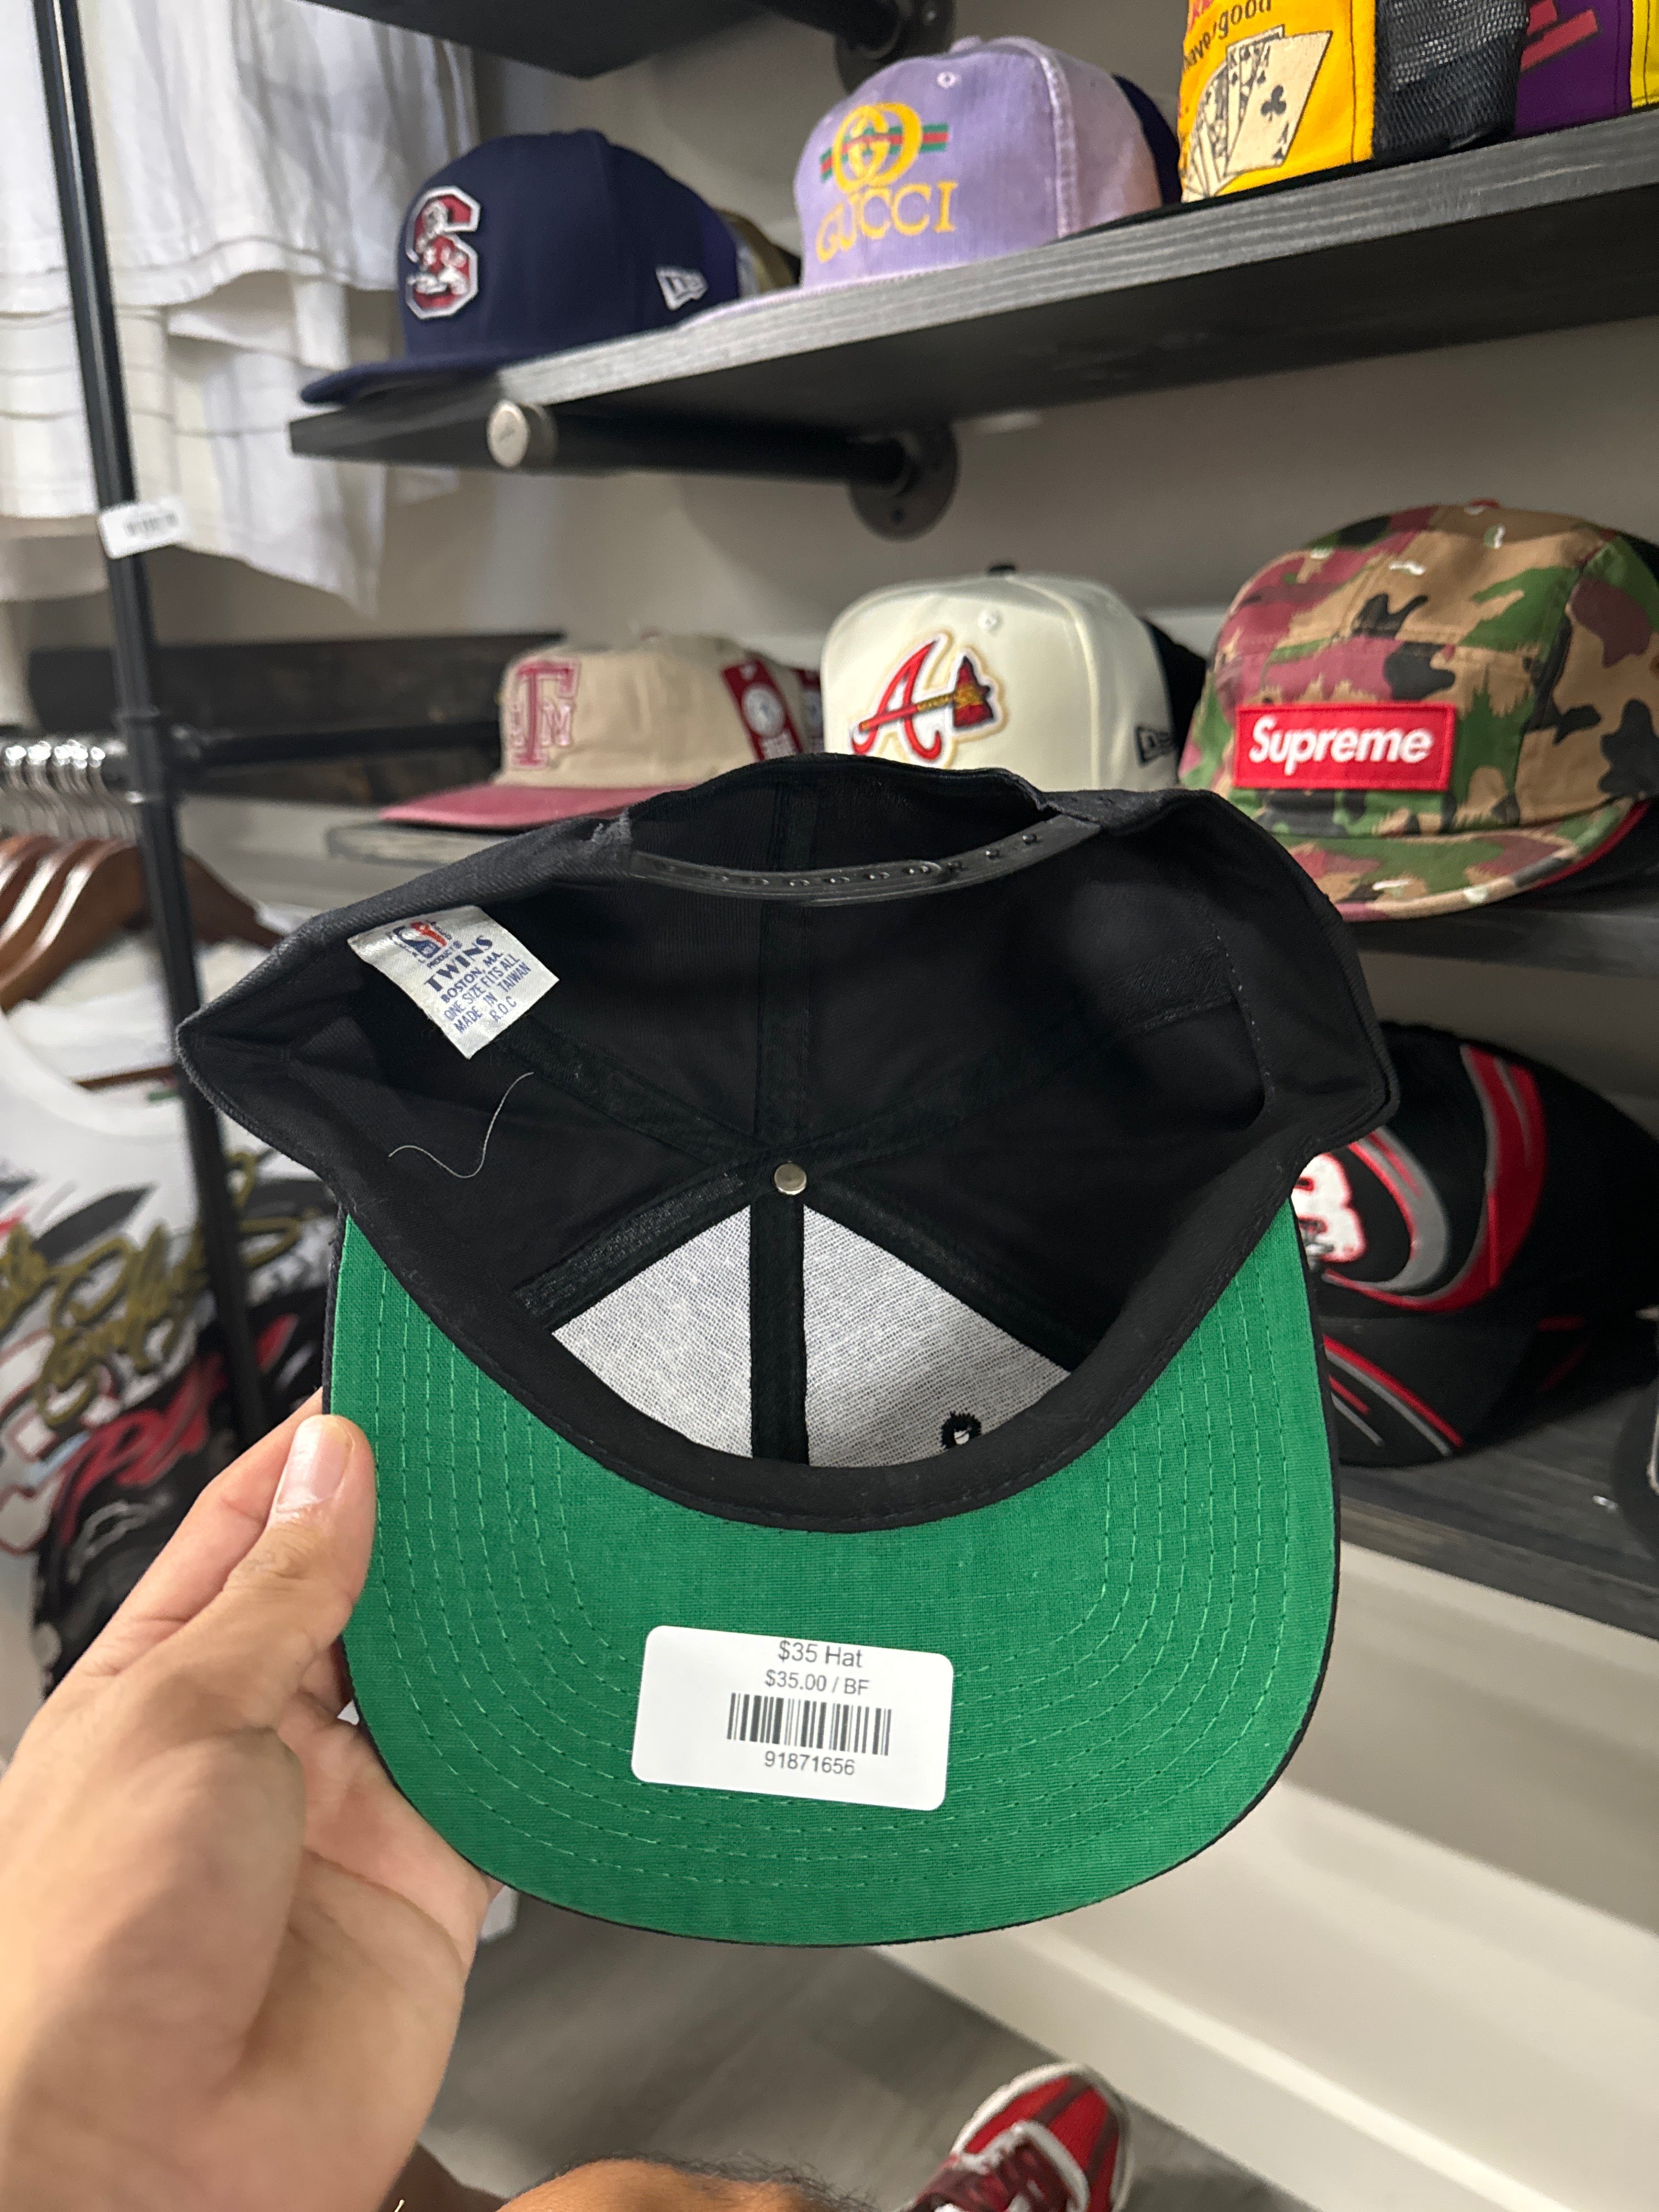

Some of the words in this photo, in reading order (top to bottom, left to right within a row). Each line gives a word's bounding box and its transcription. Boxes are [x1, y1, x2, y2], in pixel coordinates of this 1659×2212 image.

[816, 179, 958, 263] GUCCI
[1249, 715, 1434, 776] Supreme
[424, 935, 493, 992] TWINS
[441, 967, 486, 1003] BOSTON,
[444, 1000, 466, 1021] ONE
[462, 983, 486, 1005] SIZE
[480, 967, 504, 988] FITS
[500, 953, 520, 971] ALL
[453, 1006, 483, 1034] MADE
[483, 992, 498, 1007] IN
[496, 962, 532, 992] TAIWAN
[778, 1638, 819, 1663] $35
[824, 1645, 864, 1668] Hat
[765, 1669, 827, 1692] $35.00
[843, 1677, 870, 1696] BF
[764, 1750, 855, 1776] 91871656
